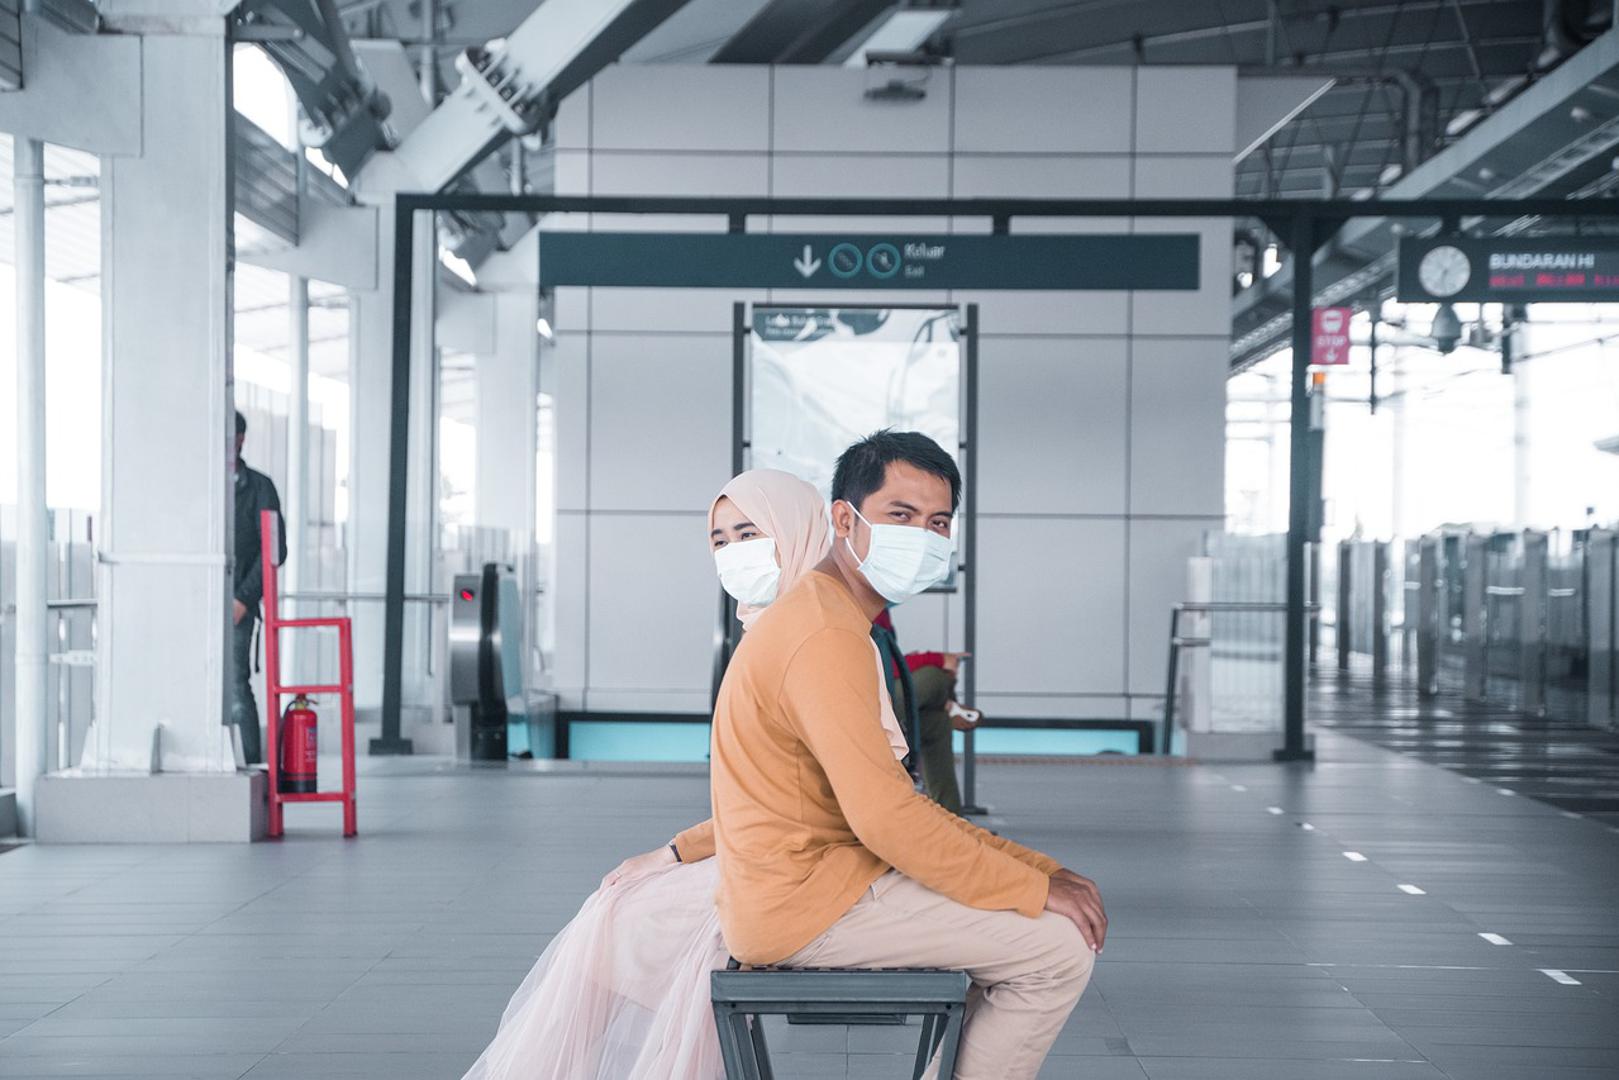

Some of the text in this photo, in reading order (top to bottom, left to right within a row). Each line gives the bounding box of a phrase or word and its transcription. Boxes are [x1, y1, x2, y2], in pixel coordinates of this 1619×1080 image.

[904, 242, 945, 258] Keluar
[1490, 253, 1595, 269] BUNDARAN HI
[1317, 335, 1346, 347] STOP
